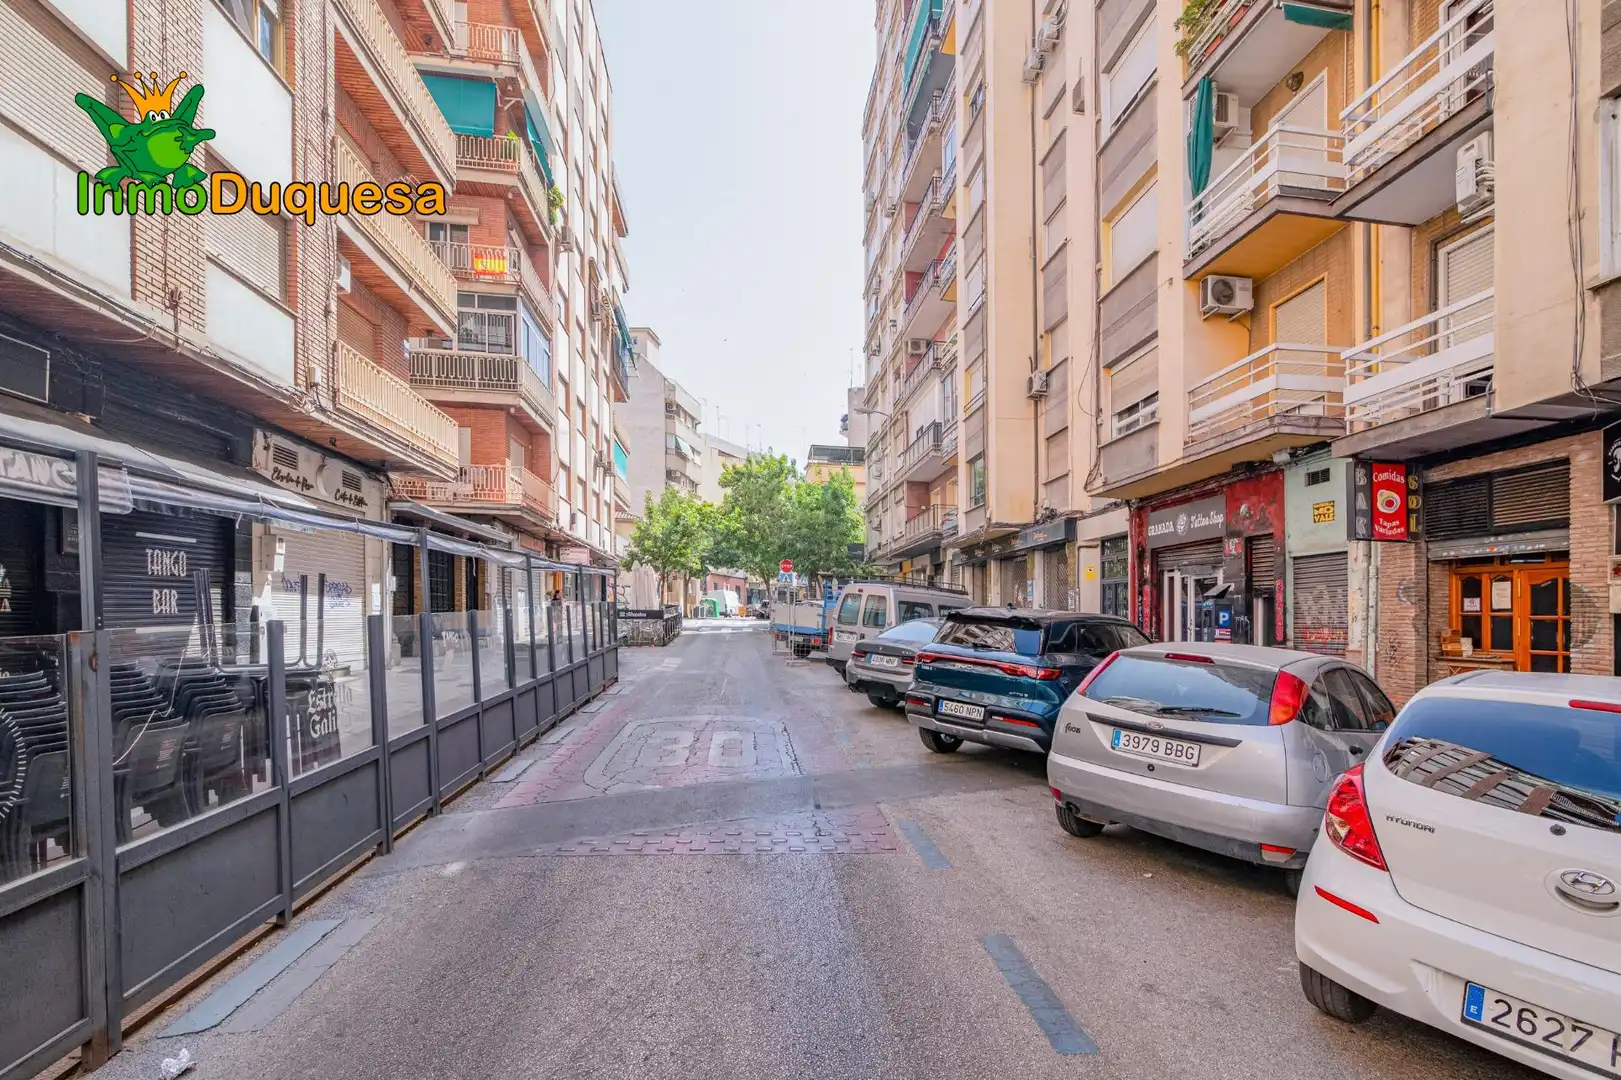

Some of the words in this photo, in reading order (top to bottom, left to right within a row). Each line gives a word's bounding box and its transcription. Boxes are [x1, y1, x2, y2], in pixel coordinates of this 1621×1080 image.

[1372, 469, 1405, 484] Comidas
[1355, 466, 1368, 536] BAR
[1408, 475, 1422, 533] SOL
[1148, 521, 1175, 537] GRANADA
[1190, 513, 1209, 529] Tattoo
[1209, 510, 1224, 529] Shop
[1379, 518, 1400, 528] Tapas
[145, 548, 187, 577] TANGO
[153, 588, 179, 614] BAR
[1219, 611, 1229, 625] P
[944, 702, 964, 715] 5460
[965, 705, 984, 718] NPN
[1122, 734, 1160, 753] 3979
[1164, 741, 1195, 760] BBG
[1386, 814, 1435, 834] HYUNDAI
[1470, 1005, 1478, 1014] E
[1491, 998, 1594, 1053] 2627
